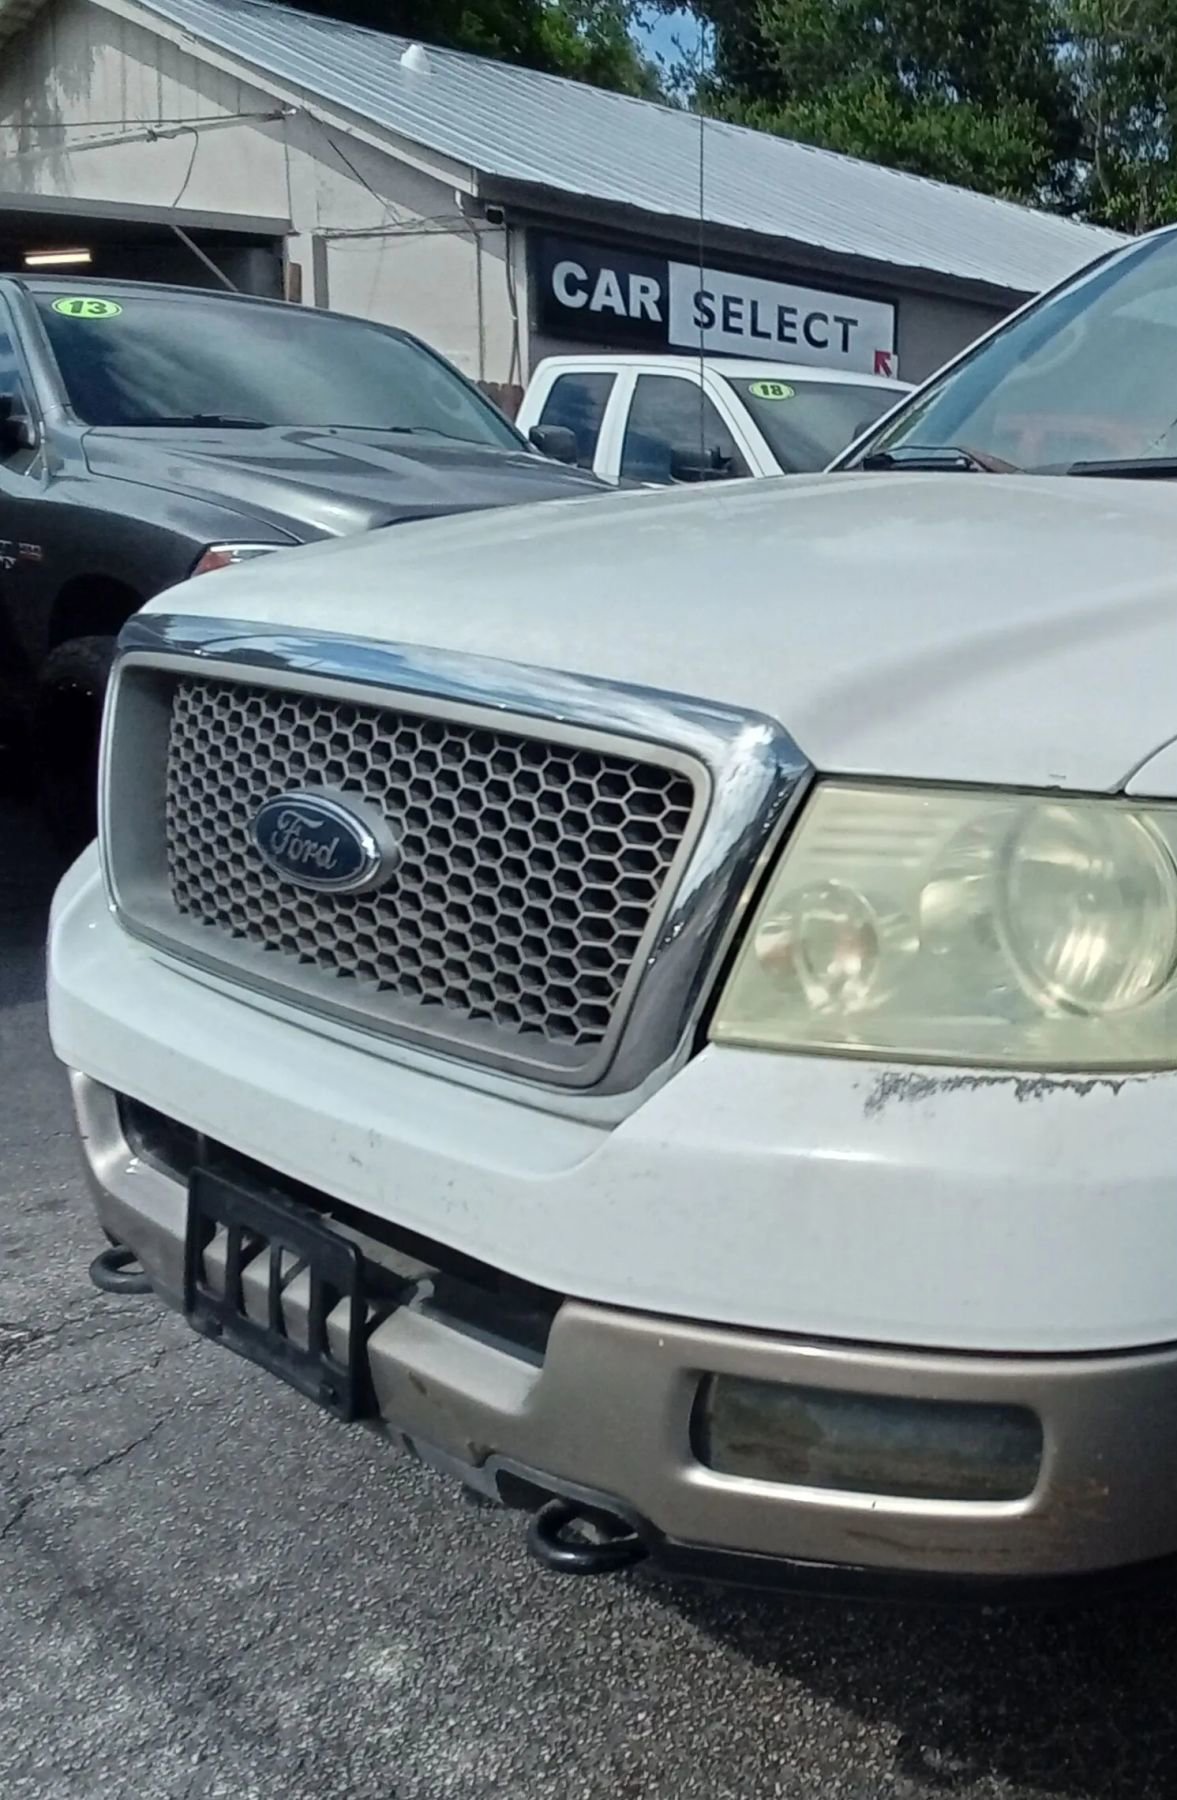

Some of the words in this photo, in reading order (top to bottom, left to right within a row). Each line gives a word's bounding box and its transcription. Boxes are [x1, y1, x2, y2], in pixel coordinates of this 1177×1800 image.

[69, 299, 107, 315] 13
[551, 260, 663, 322] CAR
[692, 290, 859, 354] SELECT
[760, 383, 783, 398] 18
[270, 809, 340, 870] Ford
